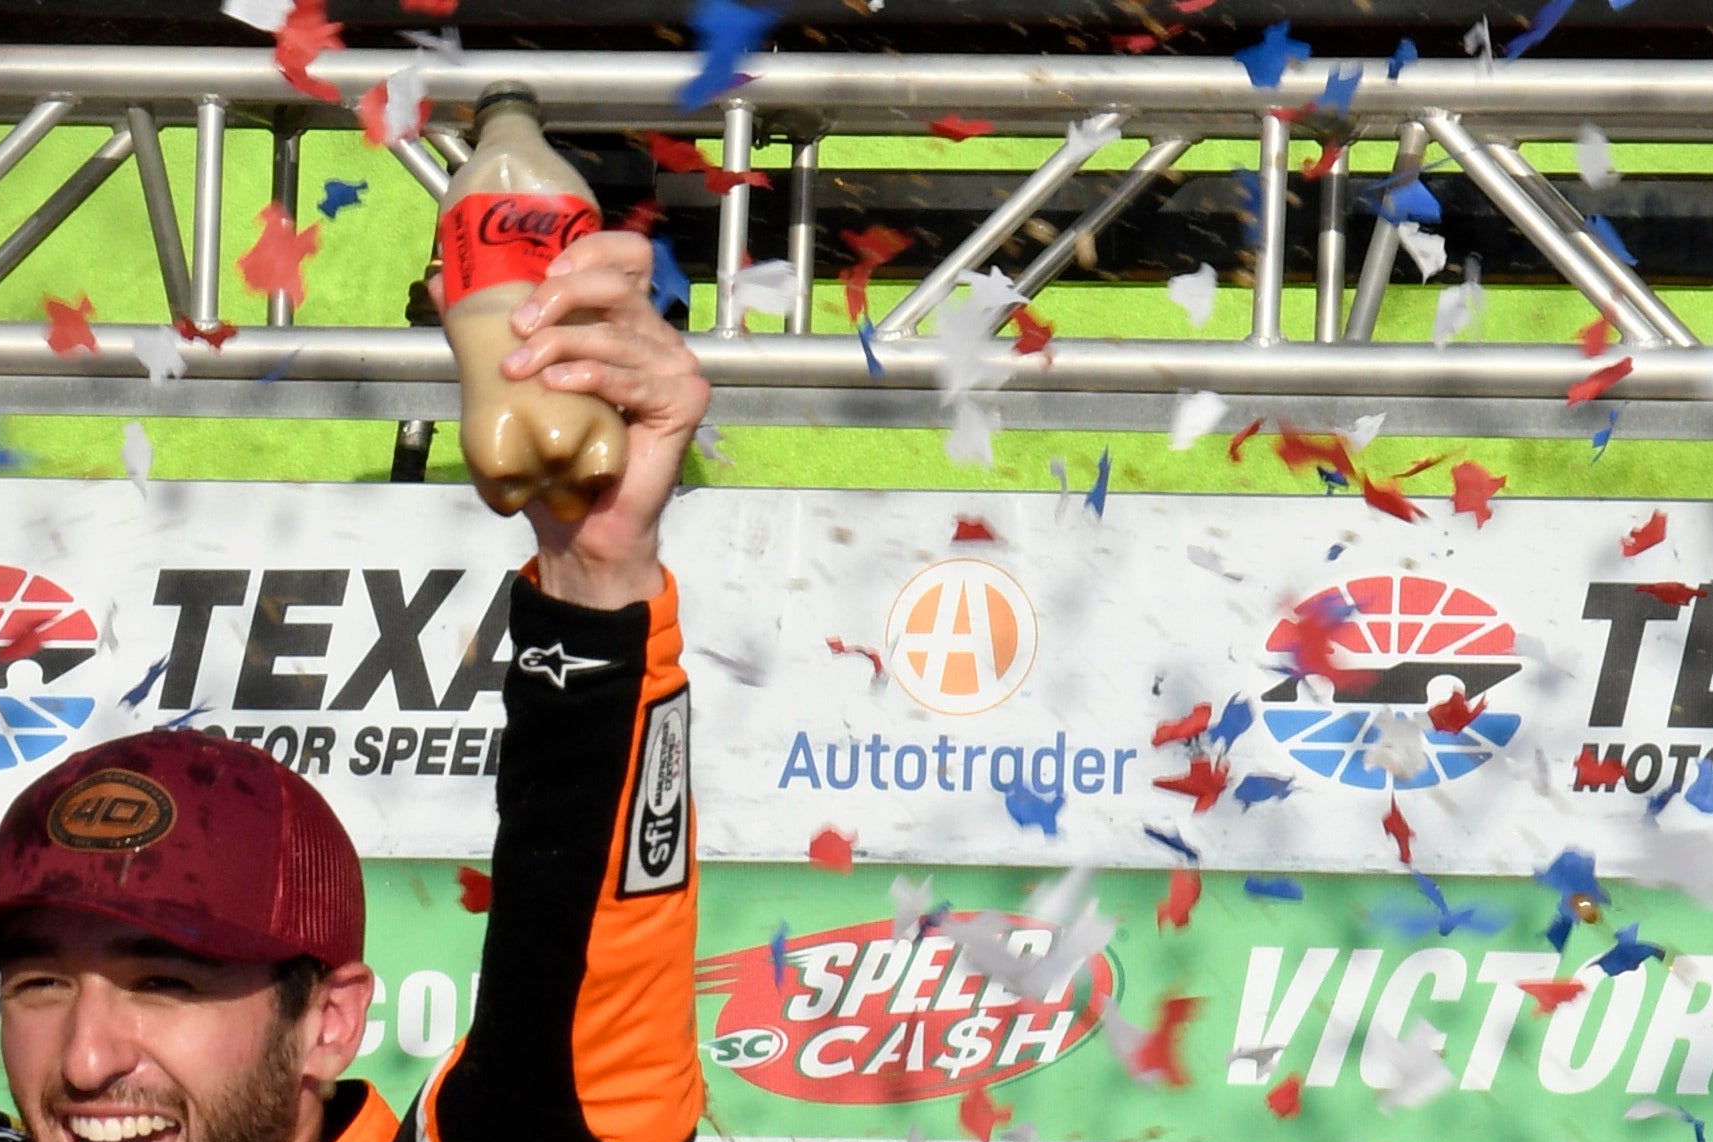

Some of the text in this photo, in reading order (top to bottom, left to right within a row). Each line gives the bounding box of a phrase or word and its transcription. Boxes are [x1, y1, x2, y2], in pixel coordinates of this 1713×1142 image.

[348, 726, 501, 777] SPEE
[778, 730, 1137, 796] Autotrader
[644, 816, 674, 866] sfi
[1226, 946, 1713, 1095] VICTOR
[714, 1033, 775, 1063] SC
